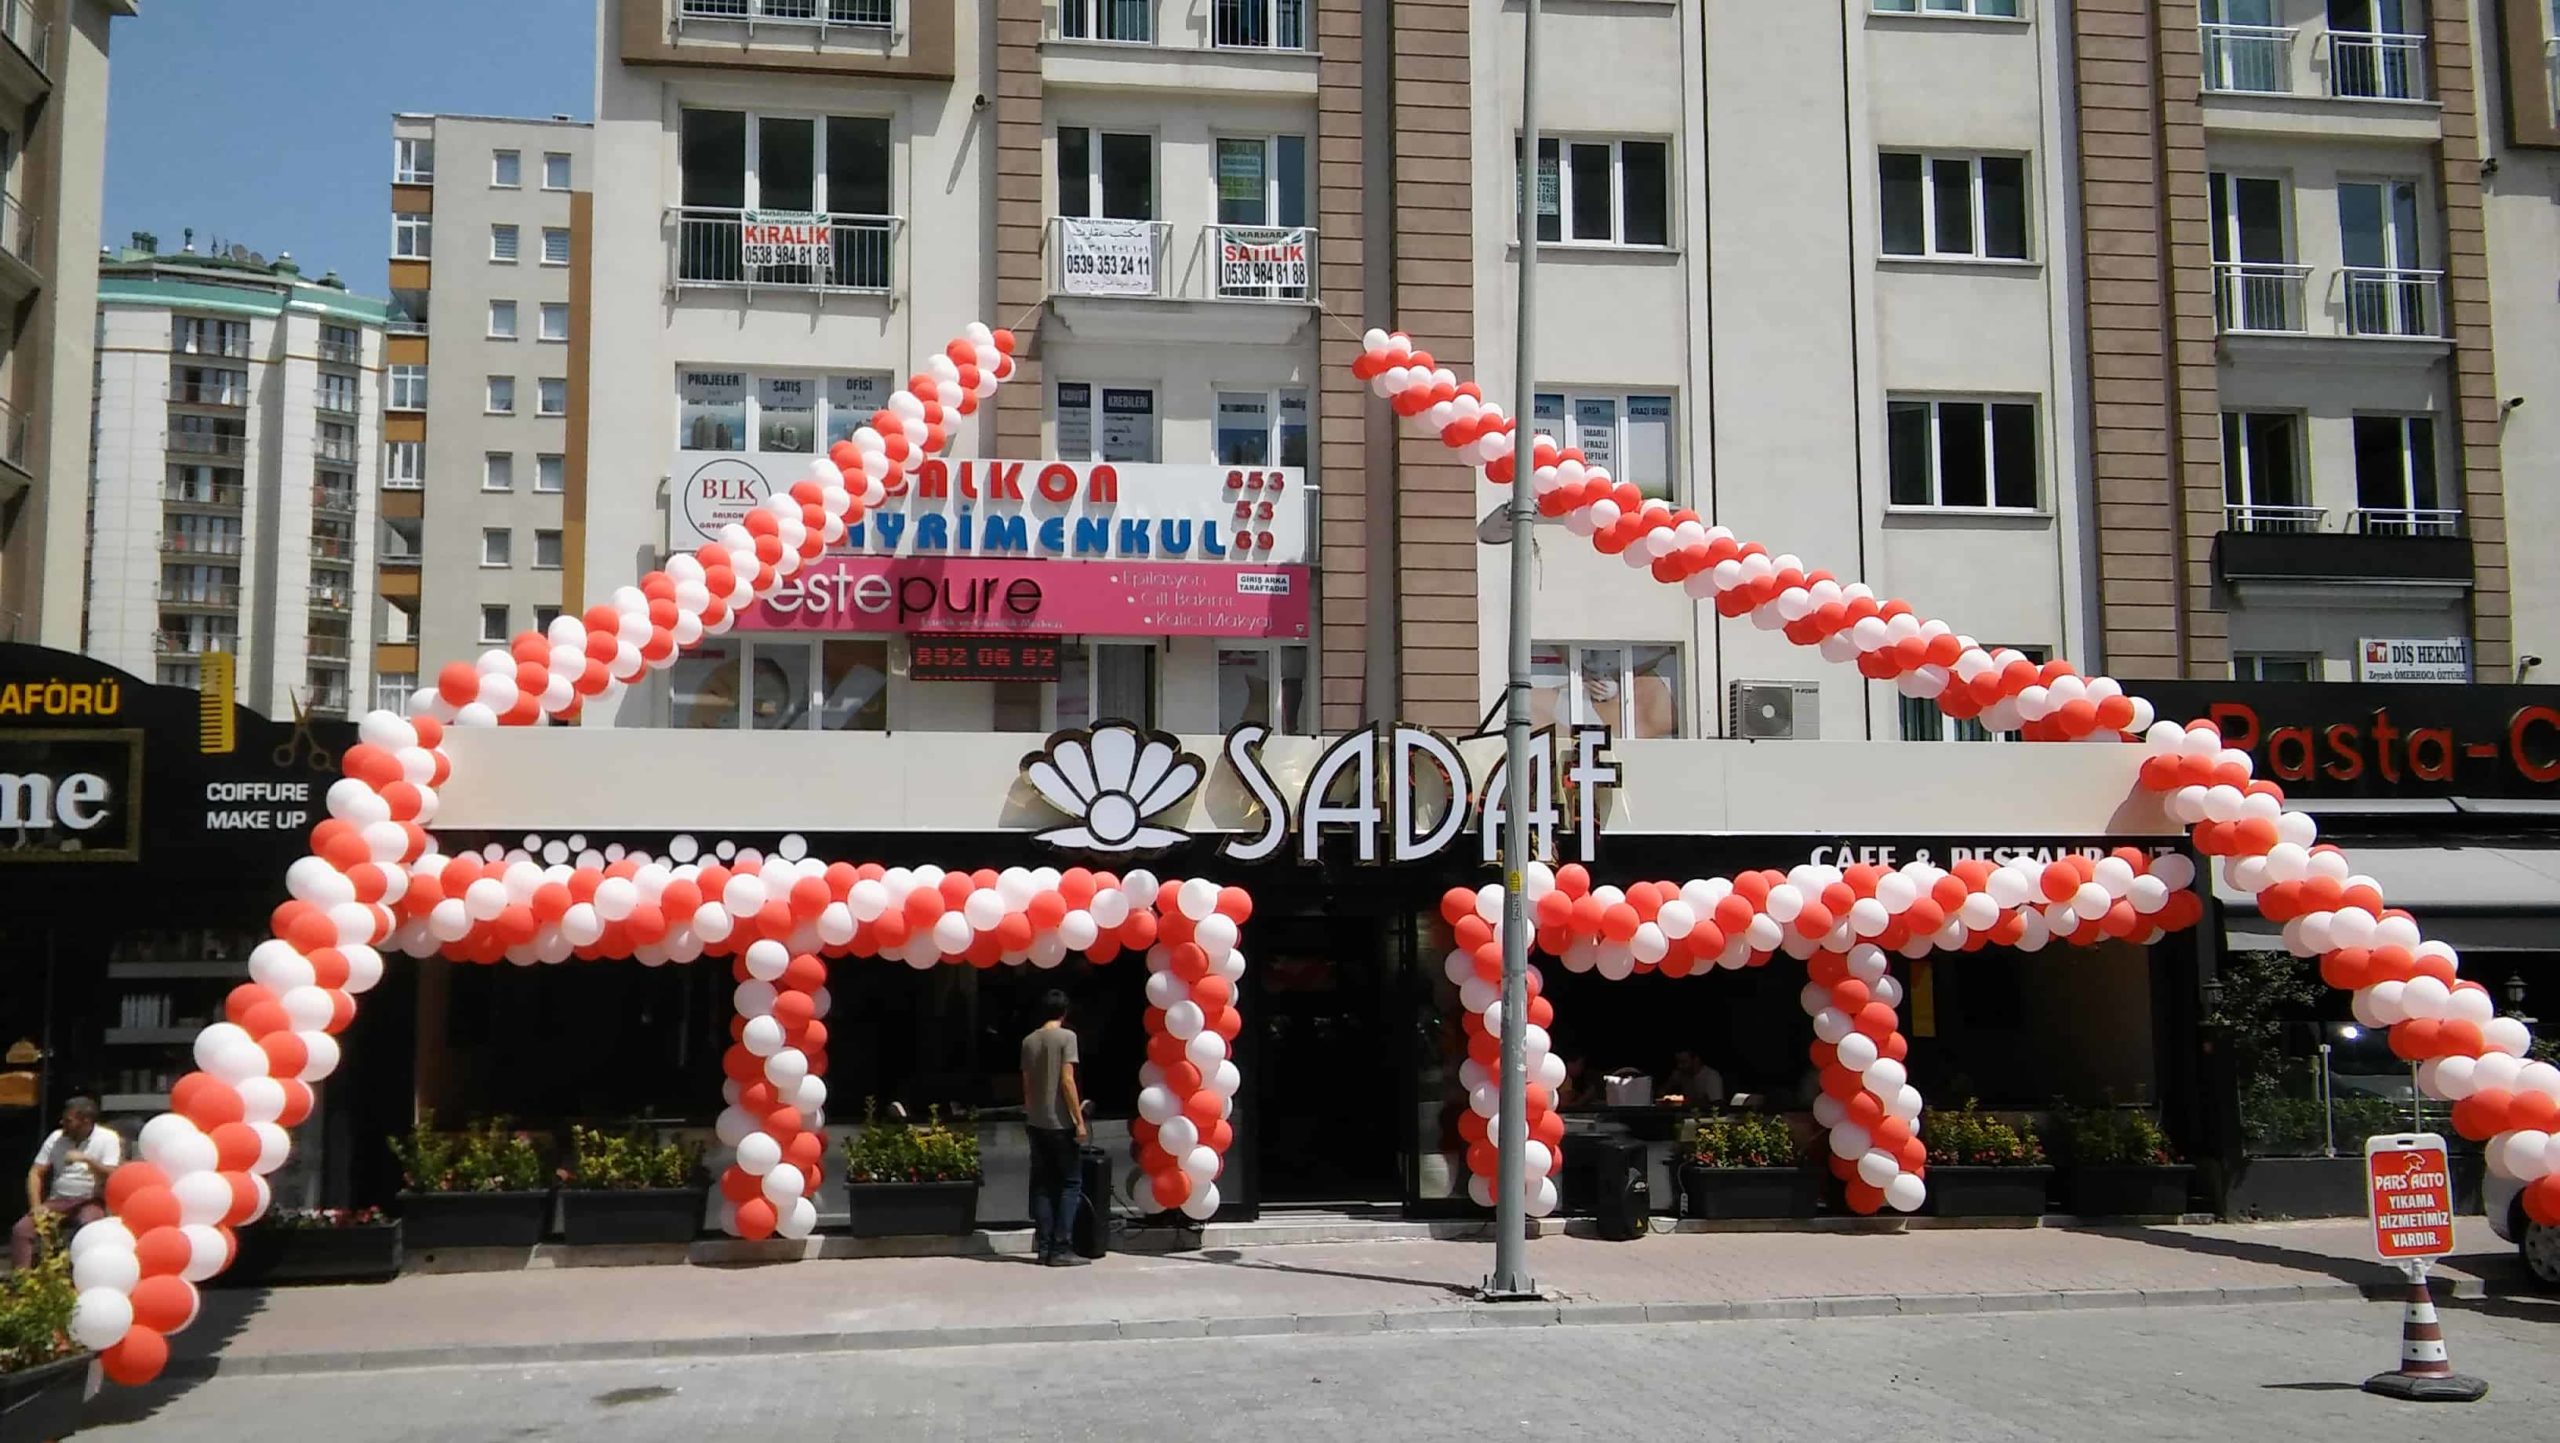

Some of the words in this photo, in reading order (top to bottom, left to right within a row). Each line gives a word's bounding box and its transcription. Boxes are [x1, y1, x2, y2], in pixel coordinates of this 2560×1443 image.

[745, 245, 773, 264] 0538
[775, 246, 796, 264] 984
[799, 246, 812, 264] 81
[816, 246, 830, 265] 88
[1066, 255, 1094, 274] 0539
[1097, 255, 1118, 275] 353
[1120, 256, 1134, 275] 24
[1137, 256, 1150, 276] 11
[1224, 263, 1250, 285] 0538
[1254, 263, 1274, 284] 984
[1276, 264, 1289, 285] 81
[1292, 264, 1306, 285] 88
[688, 374, 740, 387] PROJELER
[772, 380, 801, 395] SATIŞ
[702, 478, 758, 501] BLK
[886, 459, 1118, 503] ALKON
[1226, 471, 1286, 492] 853
[1235, 500, 1275, 521] 53
[1235, 529, 1275, 551] 69
[916, 647, 968, 666] 852
[976, 648, 1011, 667] 06
[1021, 648, 1056, 667] 52
[2391, 641, 2414, 667] DİŞ
[2416, 640, 2466, 665] HEKİMİ
[206, 783, 309, 802] COIFFURE
[206, 811, 271, 830] MAKE
[276, 811, 307, 830] UP
[1916, 848, 1936, 868] &
[2375, 1174, 2408, 1191] PARS
[2410, 1172, 2445, 1189] AUTO
[2388, 1193, 2436, 1209] YIKAMA
[2379, 1210, 2450, 1230] HİZMETİMİZ
[2391, 1231, 2441, 1248] VARDIR.
